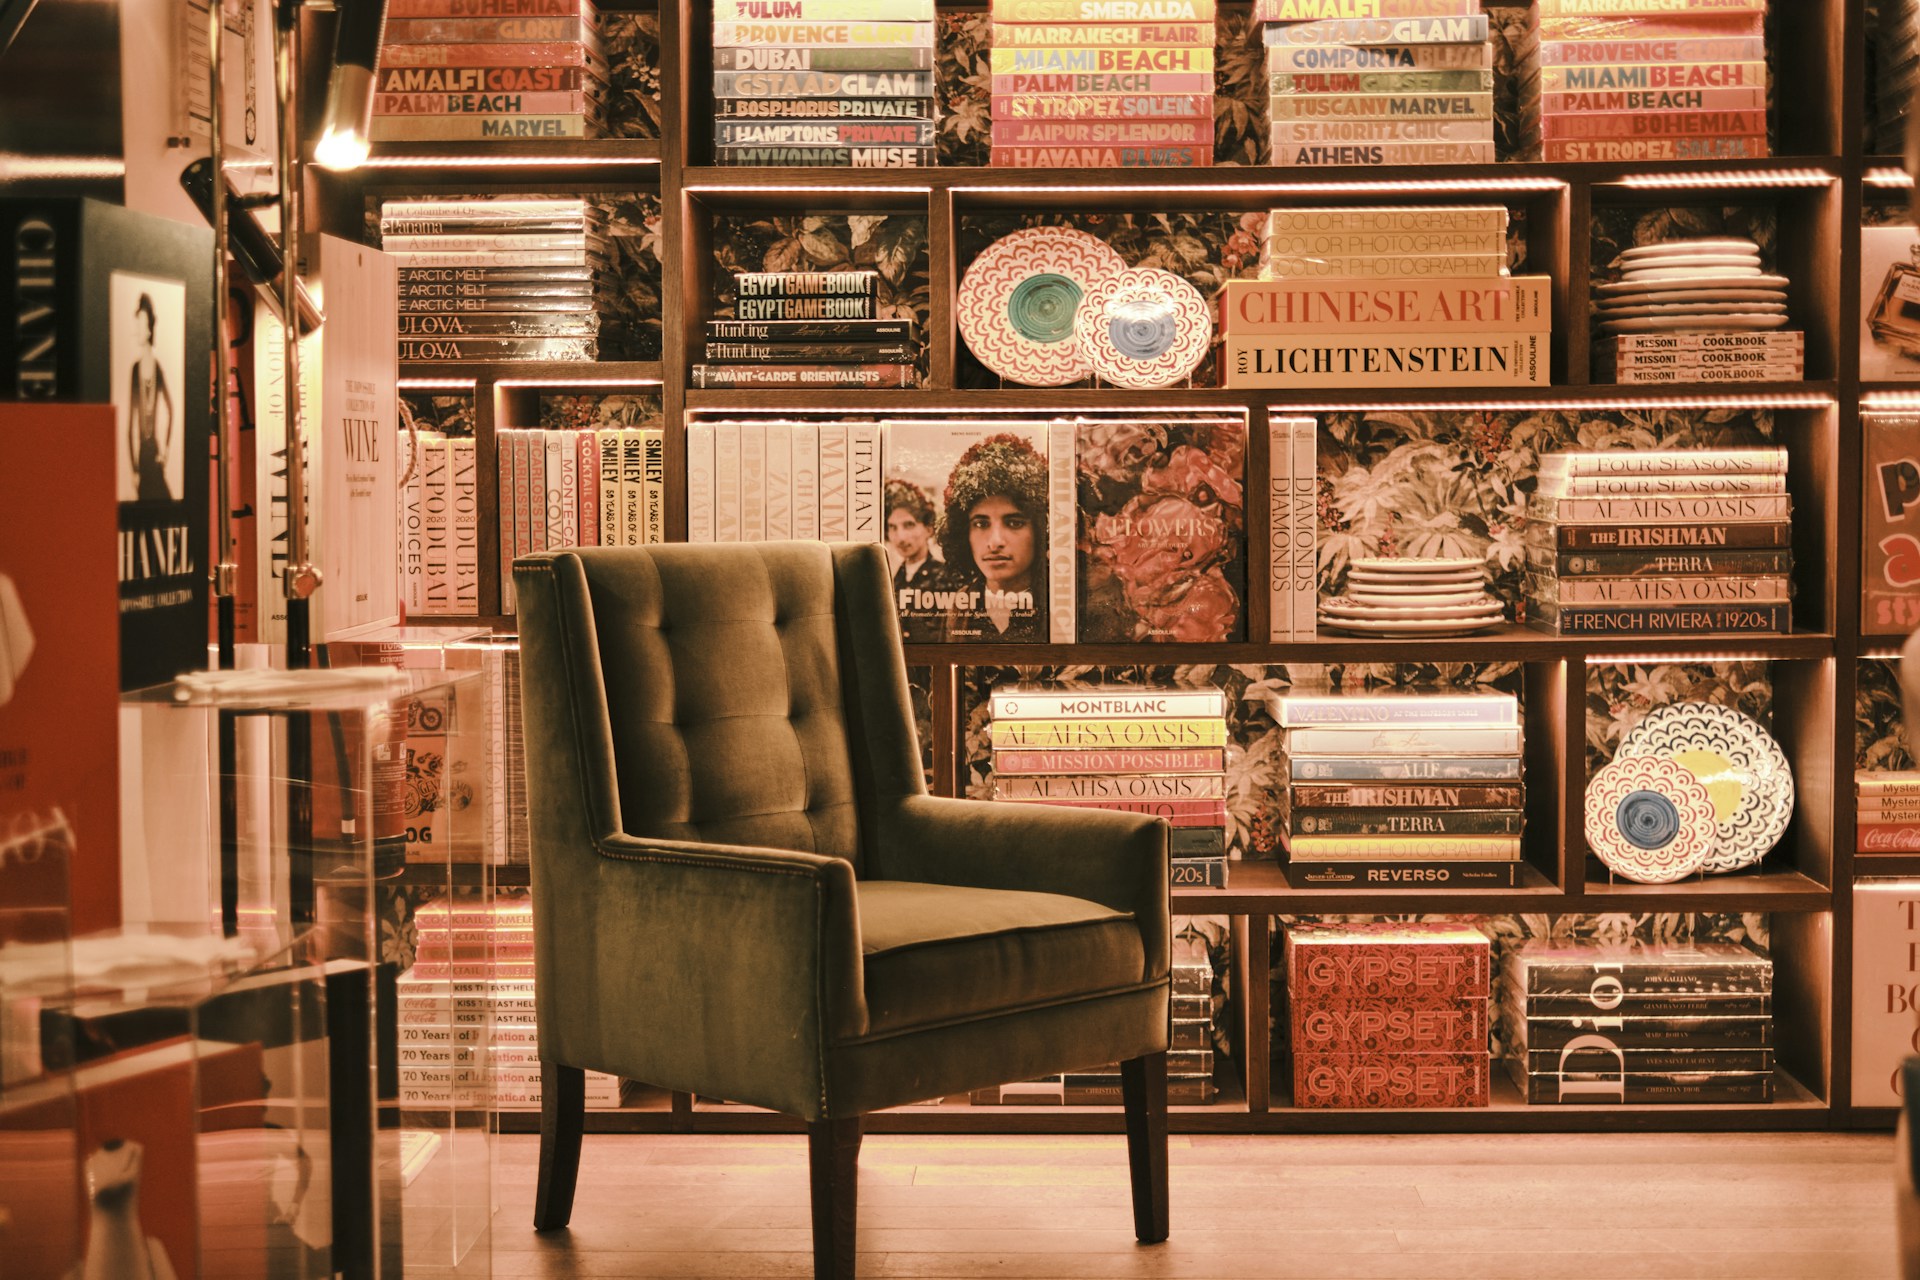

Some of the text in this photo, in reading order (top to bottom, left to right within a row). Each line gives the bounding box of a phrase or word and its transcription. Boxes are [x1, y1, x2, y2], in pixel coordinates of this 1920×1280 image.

[735, 1, 802, 19] TULUM
[1080, 1, 1196, 19] SMERALDA
[1278, 0, 1381, 19] AMALFI
[500, 20, 563, 40] GLORY
[736, 25, 848, 43] PROVENCE
[1014, 26, 1199, 44] MARRAKECH FLAIR
[1394, 19, 1470, 42] GLAM
[735, 49, 811, 70] DUBAI
[1015, 50, 1191, 71] MIAMI BEACH
[1292, 48, 1416, 69] COMPORTA
[1562, 42, 1678, 62] PROVENCE
[384, 68, 564, 91] AMALFI COAST
[735, 73, 916, 96] GSTAAD GLAM
[1013, 75, 1151, 92] PALM BEACH
[1292, 74, 1361, 94] TULUM
[1565, 65, 1744, 89] MIAMI BEACH
[384, 94, 521, 113] PALM BEACH
[736, 100, 918, 117] BOSPHORUS PRIVATE
[1293, 98, 1475, 117] TUSCANY MARVEL
[1563, 91, 1703, 111] PALM BEACH
[482, 120, 566, 137] MARVEL
[1016, 124, 1196, 142] JAIPUR SPLENDOR
[1402, 122, 1451, 141] CHIC
[1633, 113, 1747, 134] BOHEMIA
[736, 125, 917, 143] HAMPTONS PRIVATE
[736, 148, 917, 167] MYKONOS MUSE
[1014, 148, 1120, 167] HAVANA
[1296, 144, 1477, 165] ATHENS RIVIERA
[390, 219, 444, 234] Panama
[1276, 213, 1492, 231] COLOR PHOTOGRAPHY
[1276, 235, 1491, 254] COLOR PHOTOGRAPHY
[409, 269, 487, 281] ARCTIC MELT
[1276, 257, 1491, 276] COLOR PHOTOGRAPHY
[409, 284, 487, 296] ARCTIC MELT
[409, 299, 488, 311] ARCTIC MELT
[1239, 289, 1510, 324] CHINESE ART
[1635, 337, 1767, 348] MISSONI COOKBOOK
[1237, 349, 1248, 375] ROY
[1253, 346, 1509, 374] LICHTENSTEIN
[1634, 353, 1766, 364] MISSONI COOKBOOK
[800, 370, 880, 382] ORIENTALISTS
[1633, 369, 1765, 381] MISSONI COOKBOOK
[342, 418, 379, 462] WINE
[581, 439, 593, 498] COCKTAIL
[601, 438, 618, 484] SMILEY
[623, 438, 640, 484] SMILEY
[645, 438, 662, 484] SMILEY
[1598, 457, 1753, 472] FOUR SEASONS
[425, 448, 446, 514] EXPO
[455, 448, 475, 514] EXPO
[856, 440, 872, 531] ITALIAN
[1595, 479, 1751, 494] FOUR SEASONS
[563, 459, 575, 548] MONTE-CA
[1592, 500, 1756, 519] AL-AHSA OASIS
[426, 515, 447, 523] 2020
[455, 515, 476, 523] 2020
[547, 489, 562, 549] COVA
[1111, 518, 1217, 538] FLOWERS
[407, 501, 422, 576] VOICES
[1272, 477, 1291, 592] DIAMONDS
[1295, 477, 1314, 592] DIAMONDS
[1590, 527, 1728, 546] THE IRISHMAN
[118, 526, 194, 581] HANEL
[427, 526, 447, 601] DUBAI
[457, 526, 476, 601] DUBAI
[1655, 556, 1713, 572] TERRA
[899, 588, 1034, 611] Flower Men
[1592, 582, 1757, 601] AL-AHSA OASIS
[1564, 611, 1768, 630] THE FRENCH RIVIERA 1920s
[1060, 700, 1166, 714] MONTBLANC
[1293, 706, 1390, 722] VALENTINO
[1003, 723, 1200, 745] AL-AHSA OASIS
[1042, 753, 1205, 770] MISSION POSSIBLE
[1403, 762, 1440, 777] ALIF
[1030, 779, 1192, 797] AL-AHSA OASIS
[1324, 789, 1460, 807] THE IRISHMAN
[1387, 816, 1446, 832] TERRA
[1296, 841, 1506, 858] COLOR PHOTOGRAPHY
[1368, 869, 1450, 882] REVERSO
[1308, 955, 1464, 987] GYPSET
[454, 984, 473, 992] KISS
[457, 1000, 476, 1008] KISS
[457, 1014, 476, 1022] KISS
[1305, 1010, 1462, 1042] GYPSET
[403, 1029, 470, 1041] 70 Years of
[402, 1050, 469, 1061] 70 Years of
[403, 1071, 469, 1081] 70 Years of
[1308, 1066, 1464, 1097] GYPSET
[404, 1091, 470, 1101] 70 Years of
